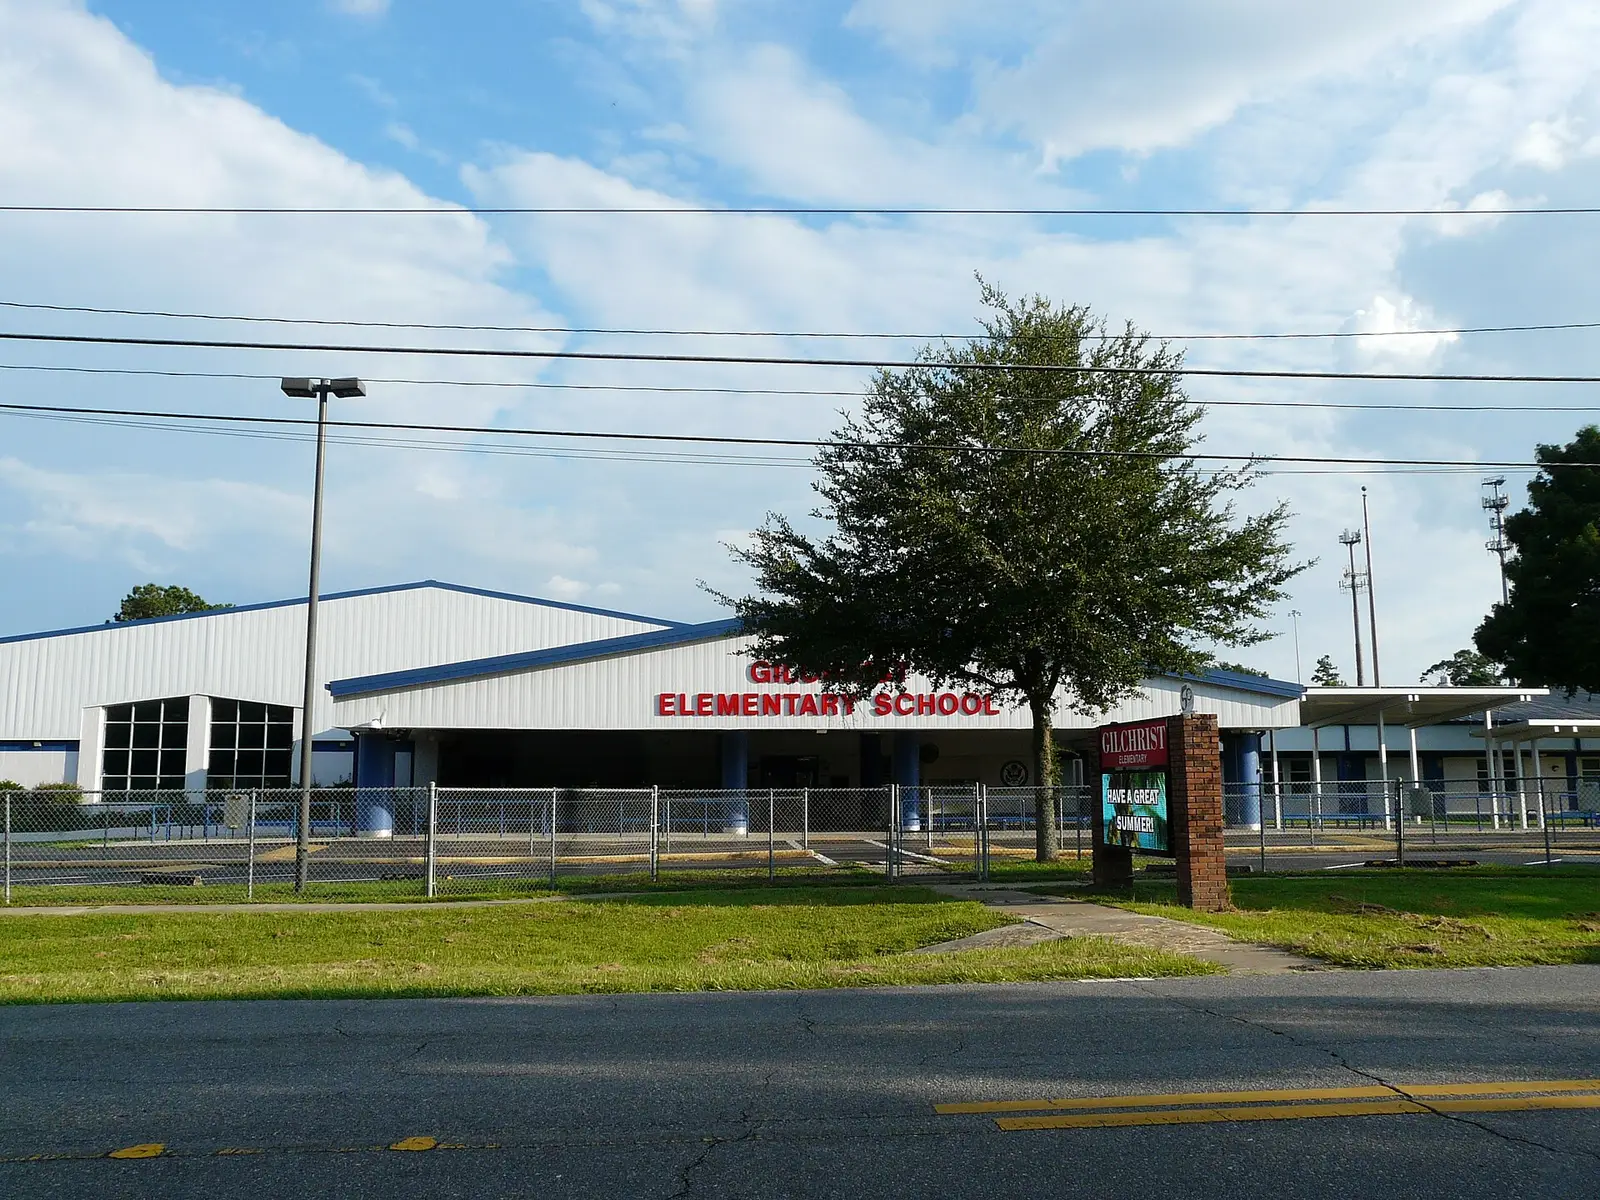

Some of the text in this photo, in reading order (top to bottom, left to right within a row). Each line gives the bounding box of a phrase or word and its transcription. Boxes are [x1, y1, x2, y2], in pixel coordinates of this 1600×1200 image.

[658, 692, 1000, 716] ELEMENTARY SCHOOL
[1102, 725, 1166, 753] GILCHRIST
[1118, 754, 1147, 764] ELEMENTARY
[1107, 789, 1159, 805] HAVE A GREAT
[1116, 815, 1154, 832] SUMMER!
